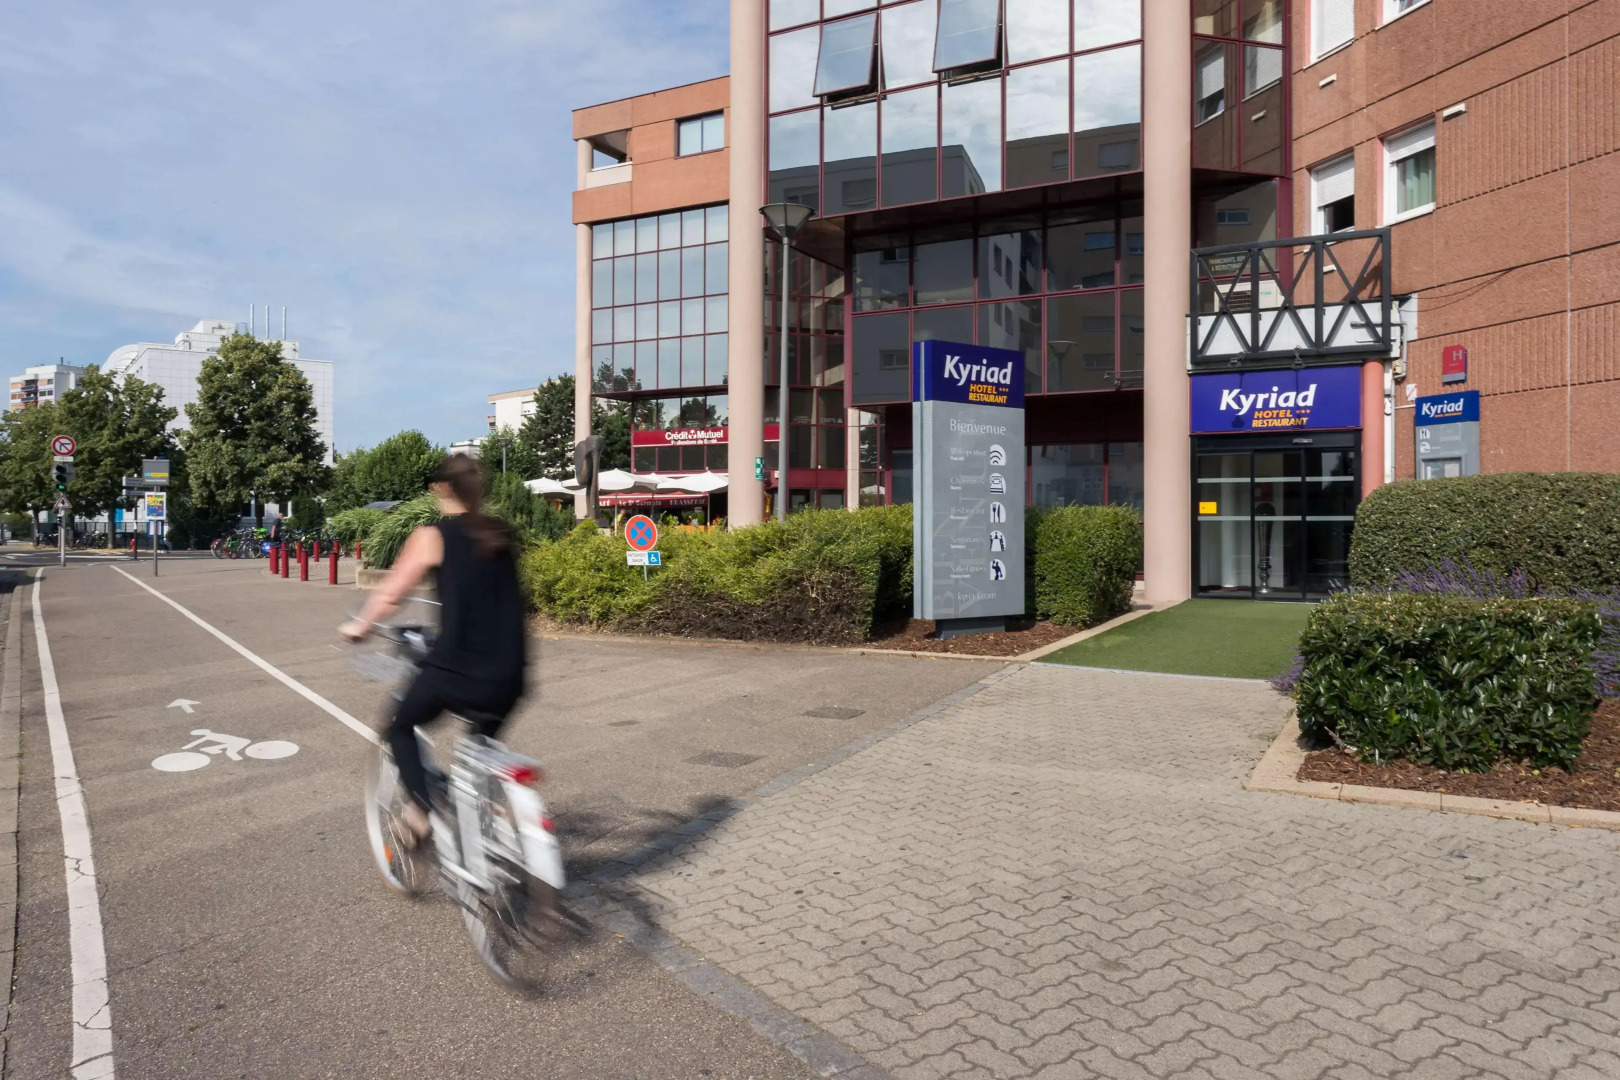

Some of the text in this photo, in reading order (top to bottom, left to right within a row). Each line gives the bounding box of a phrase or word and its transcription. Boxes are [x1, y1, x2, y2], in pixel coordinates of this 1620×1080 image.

[1452, 349, 1463, 361] H
[943, 354, 1013, 386] Kyriad
[969, 383, 998, 394] HOTEL
[968, 392, 1008, 404] RESTAURANT
[1219, 383, 1318, 416] Kyriad
[1253, 409, 1293, 419] HOTEL
[1421, 398, 1464, 418] Kyriad
[949, 418, 1007, 435] Bienvenue
[1252, 417, 1309, 428] RESTAURANT
[665, 429, 724, 441] Crédit Mutuel
